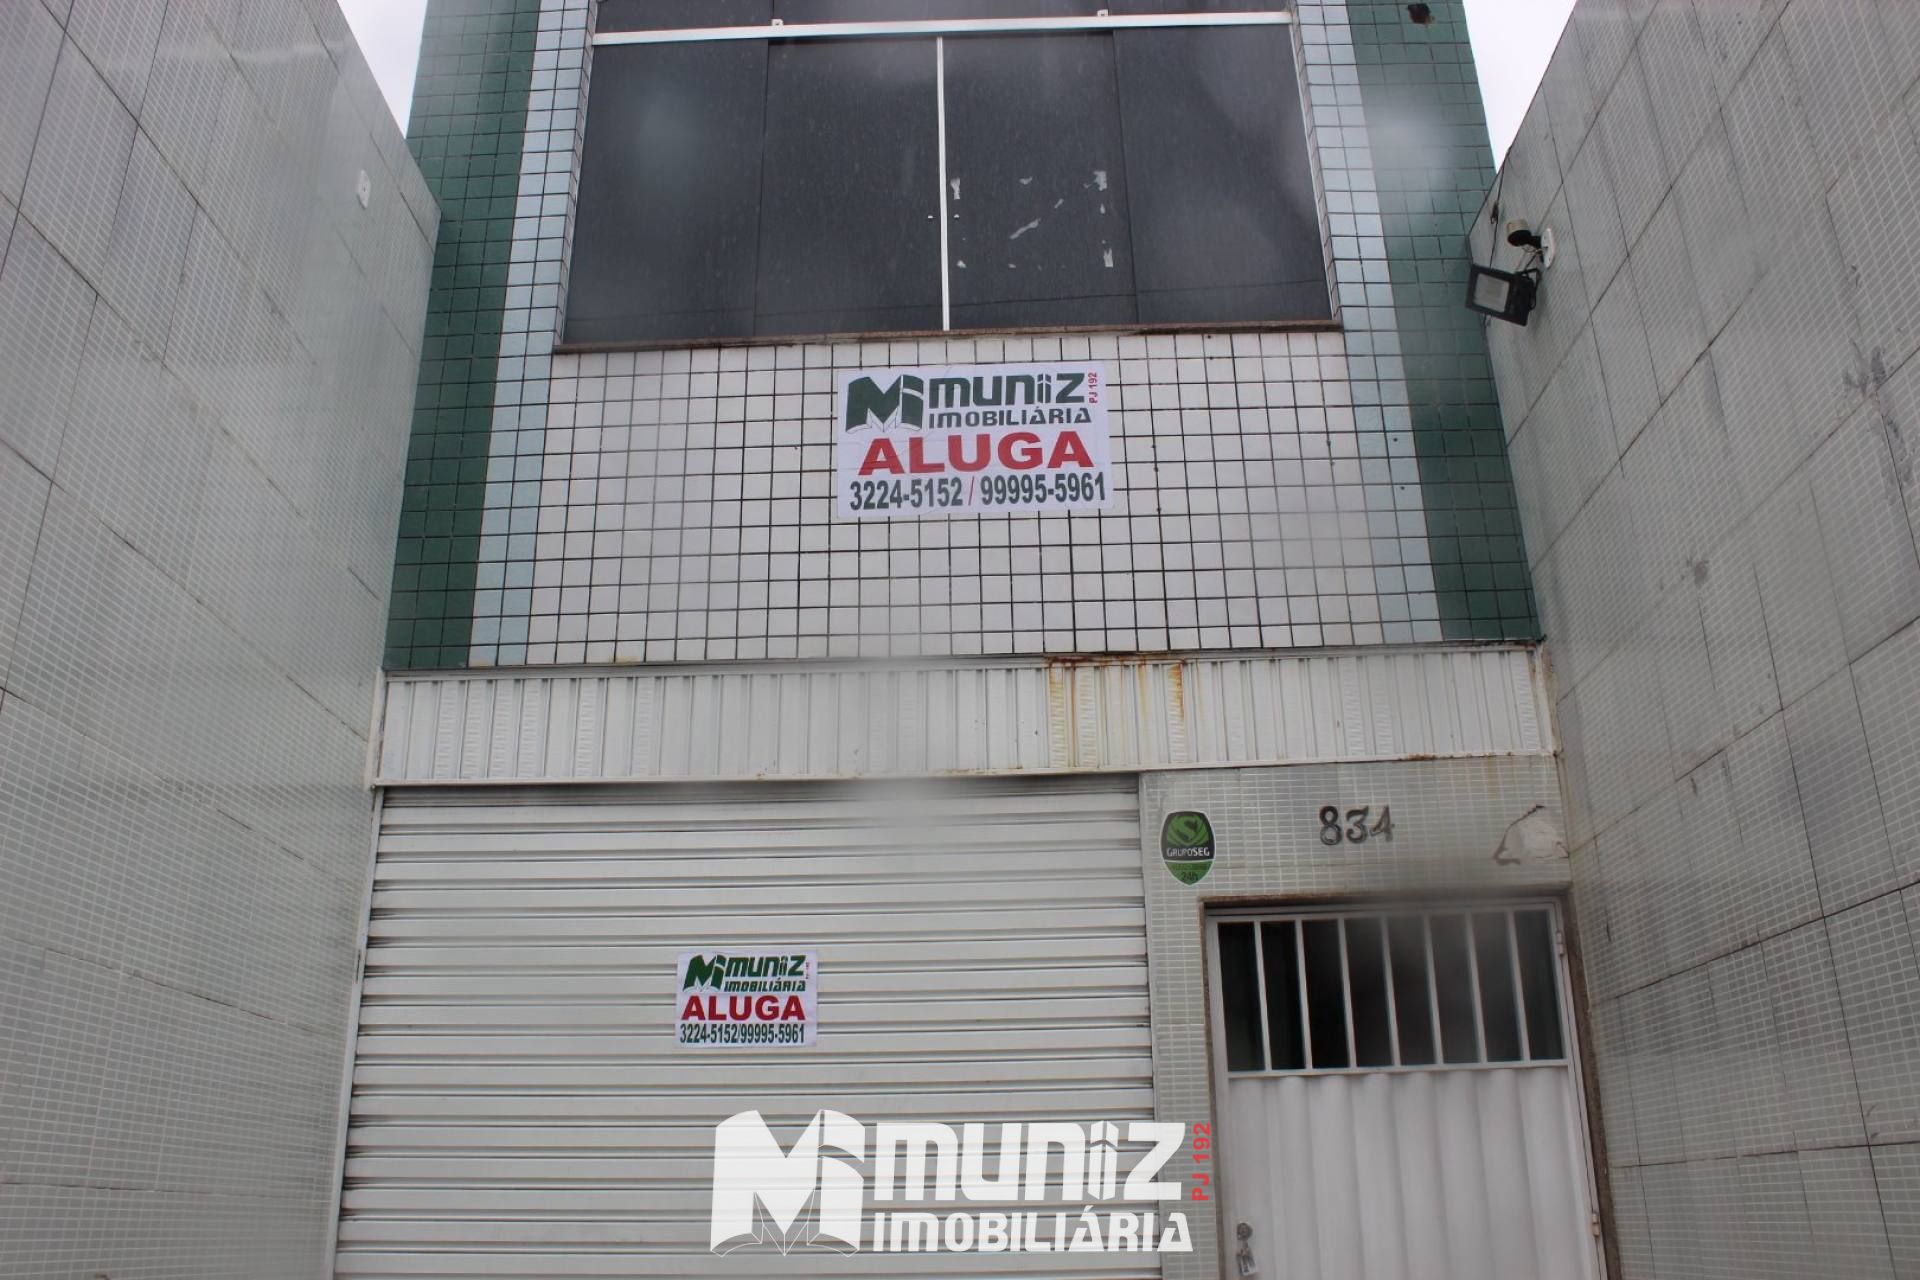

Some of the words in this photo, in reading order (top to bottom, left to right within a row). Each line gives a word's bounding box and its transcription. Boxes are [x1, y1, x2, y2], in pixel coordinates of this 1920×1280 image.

[1088, 372, 1097, 390] 192
[858, 431, 1094, 476] ALUGA
[850, 477, 963, 511] 3224-5152
[980, 472, 1105, 505] 99995-5961
[1319, 805, 1395, 846] 834
[681, 995, 806, 1021] ALUGA
